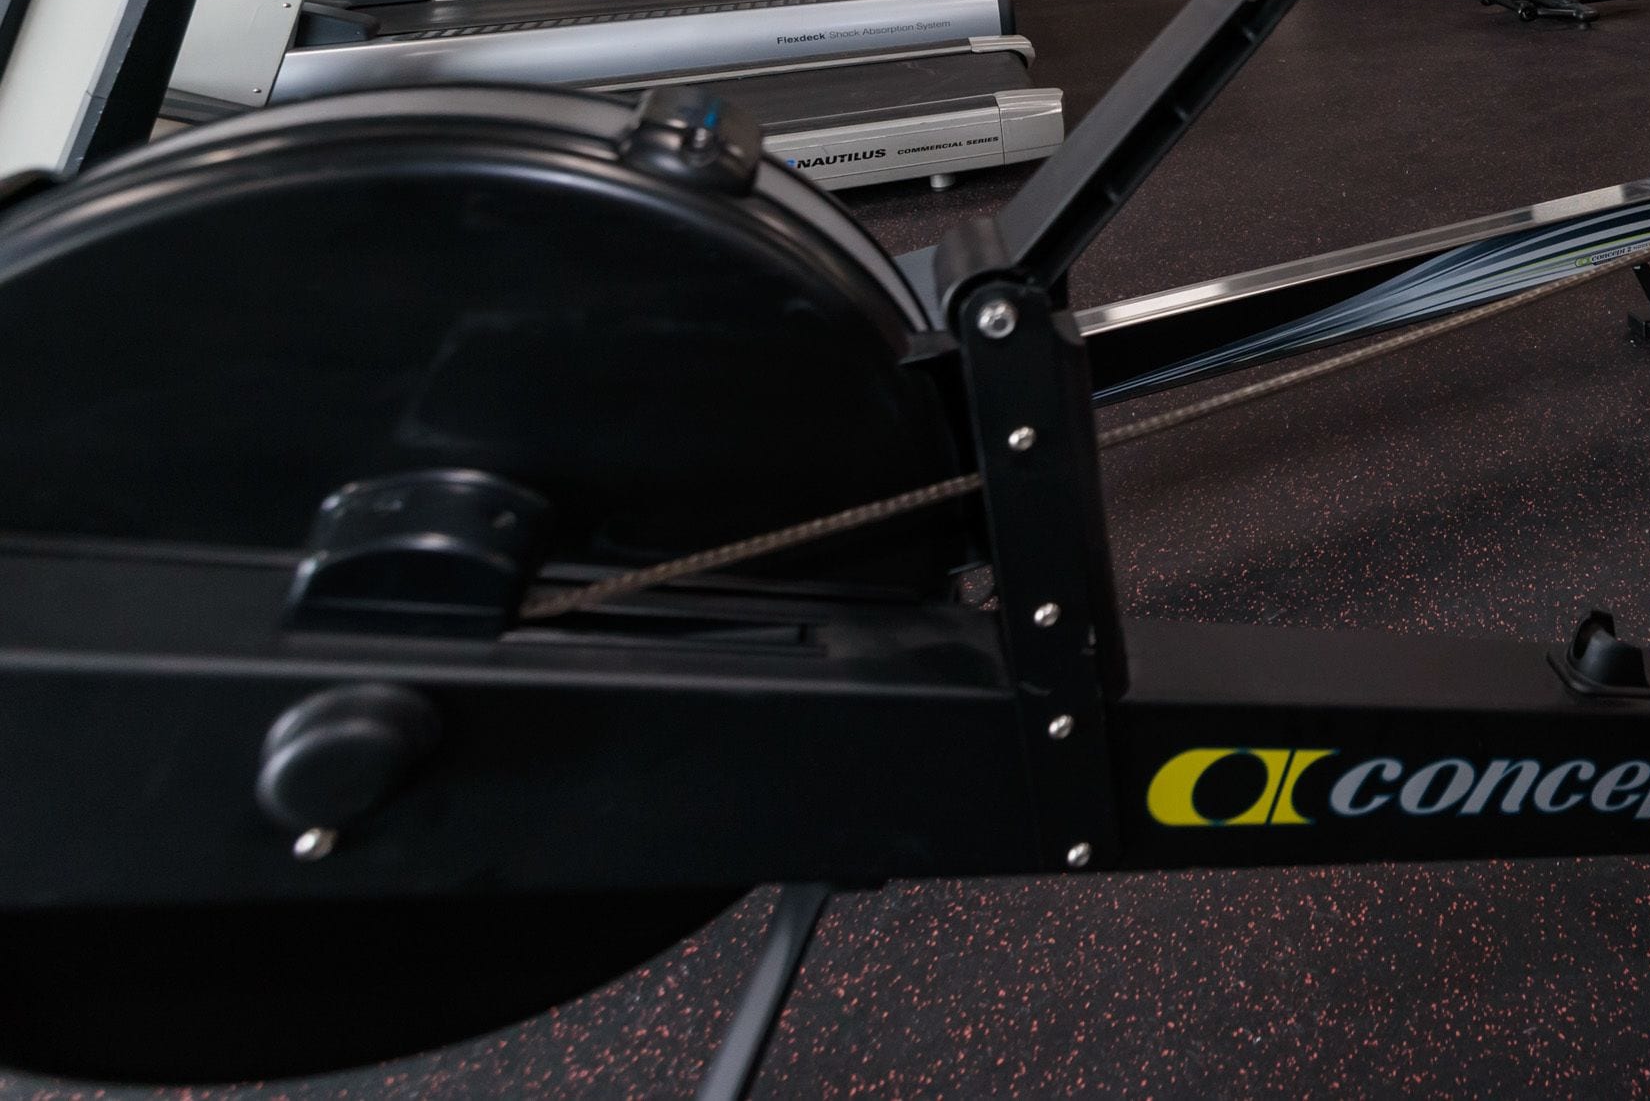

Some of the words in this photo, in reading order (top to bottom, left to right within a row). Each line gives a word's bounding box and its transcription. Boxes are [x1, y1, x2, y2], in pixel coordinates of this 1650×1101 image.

[776, 32, 826, 45] Flexdeck
[829, 29, 860, 40] Shock
[862, 23, 914, 37] Absorption
[916, 20, 951, 32] System
[797, 148, 887, 169] NAUTILUS
[897, 141, 963, 155] COMMERCIAL
[966, 136, 999, 146] SERIES
